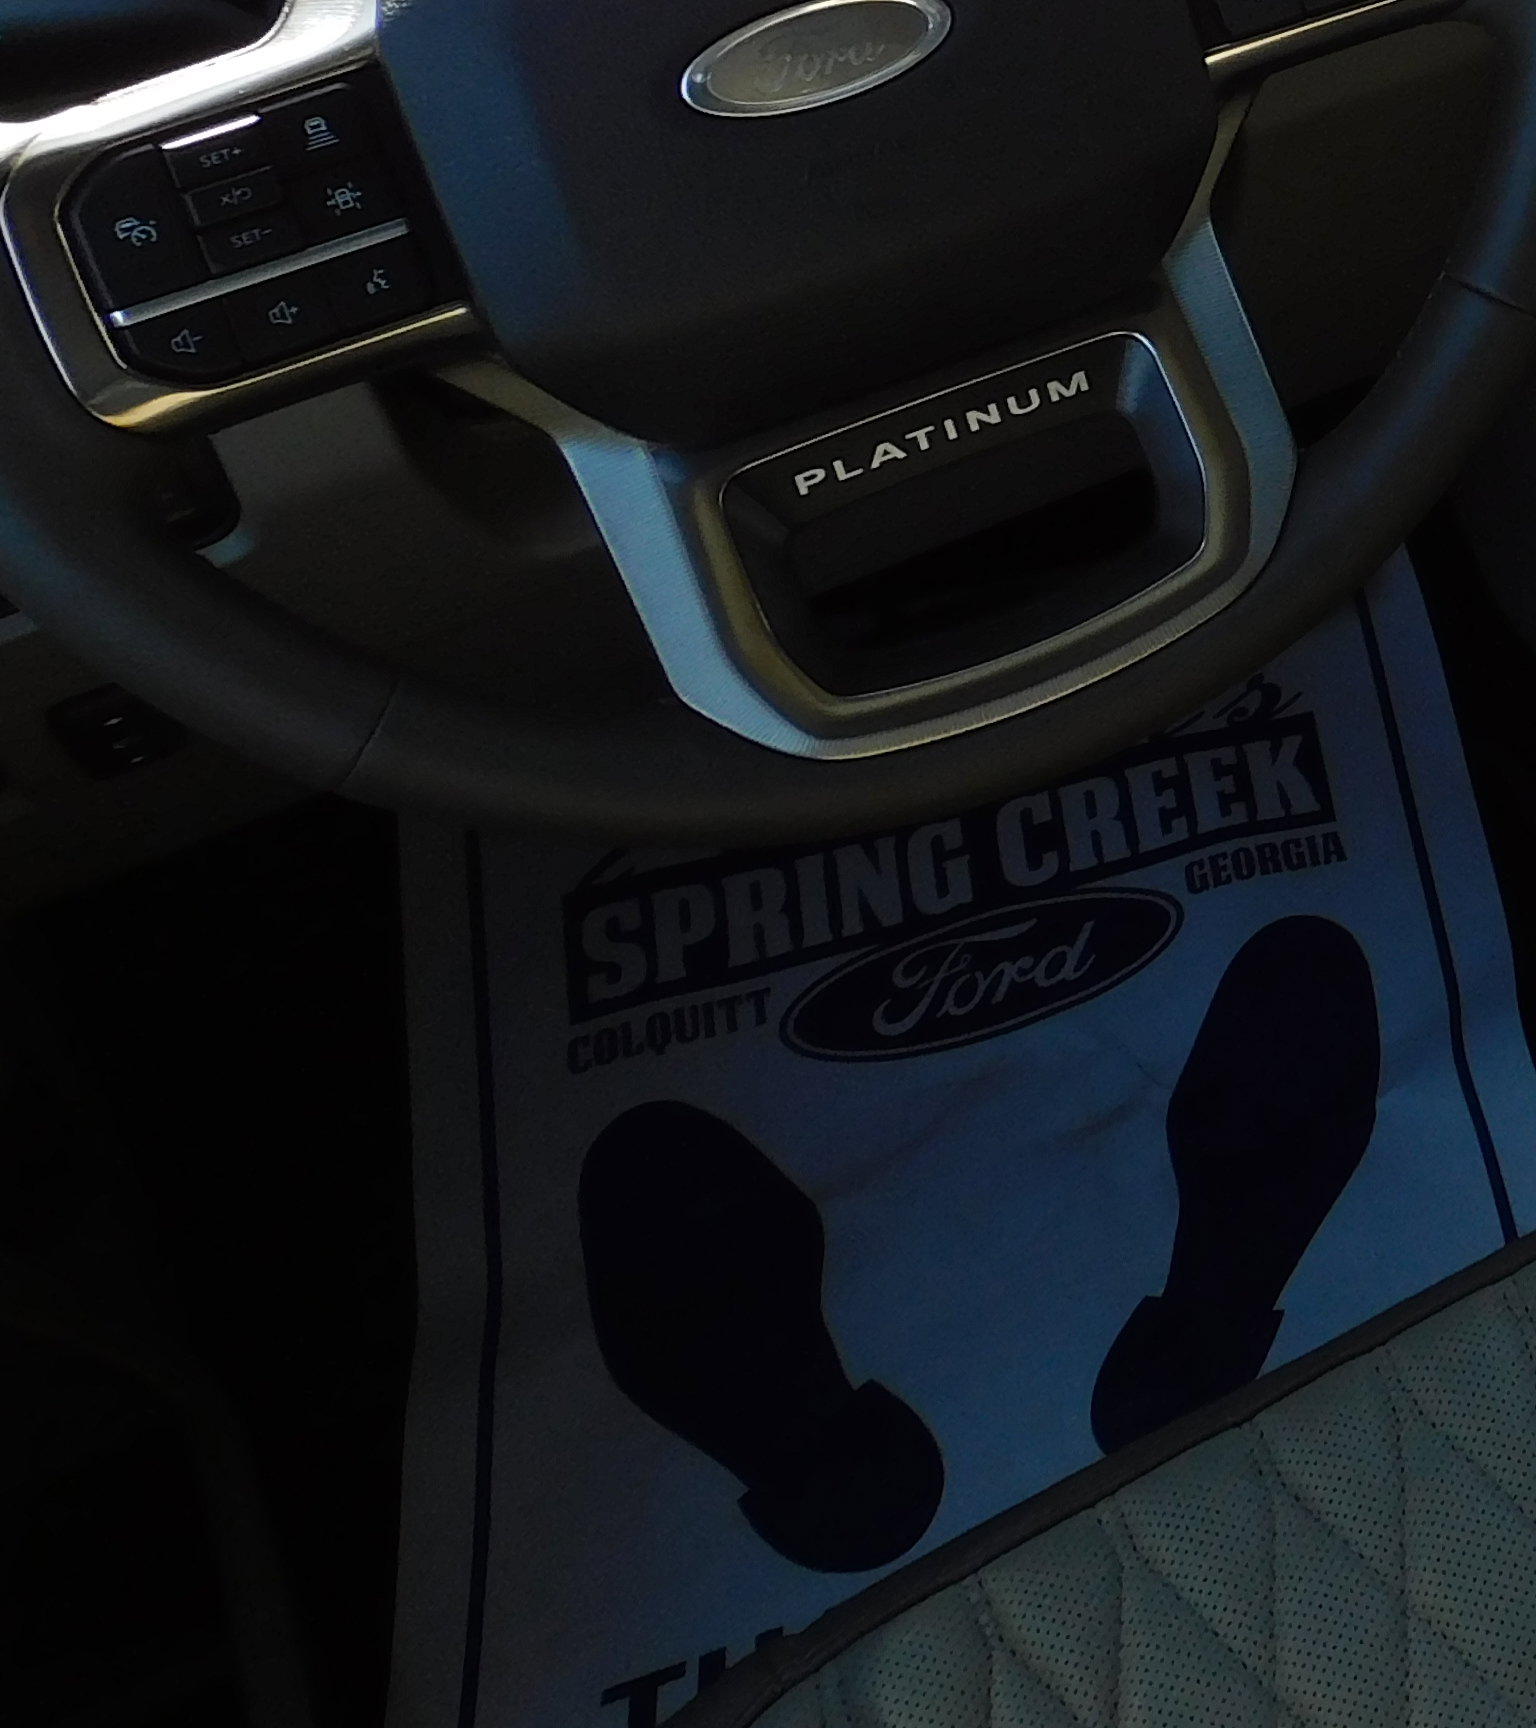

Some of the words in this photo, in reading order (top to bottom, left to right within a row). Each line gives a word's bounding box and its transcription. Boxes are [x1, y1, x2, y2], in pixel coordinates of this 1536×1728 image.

[200, 147, 242, 168] SET+
[794, 370, 1090, 495] PLATINUM
[566, 985, 772, 1075] COLQUITT
[873, 919, 1098, 1038] Ford
[1184, 830, 1348, 896] GEORGIA
[580, 818, 976, 1005] SPRING
[994, 733, 1323, 888] CREEK
